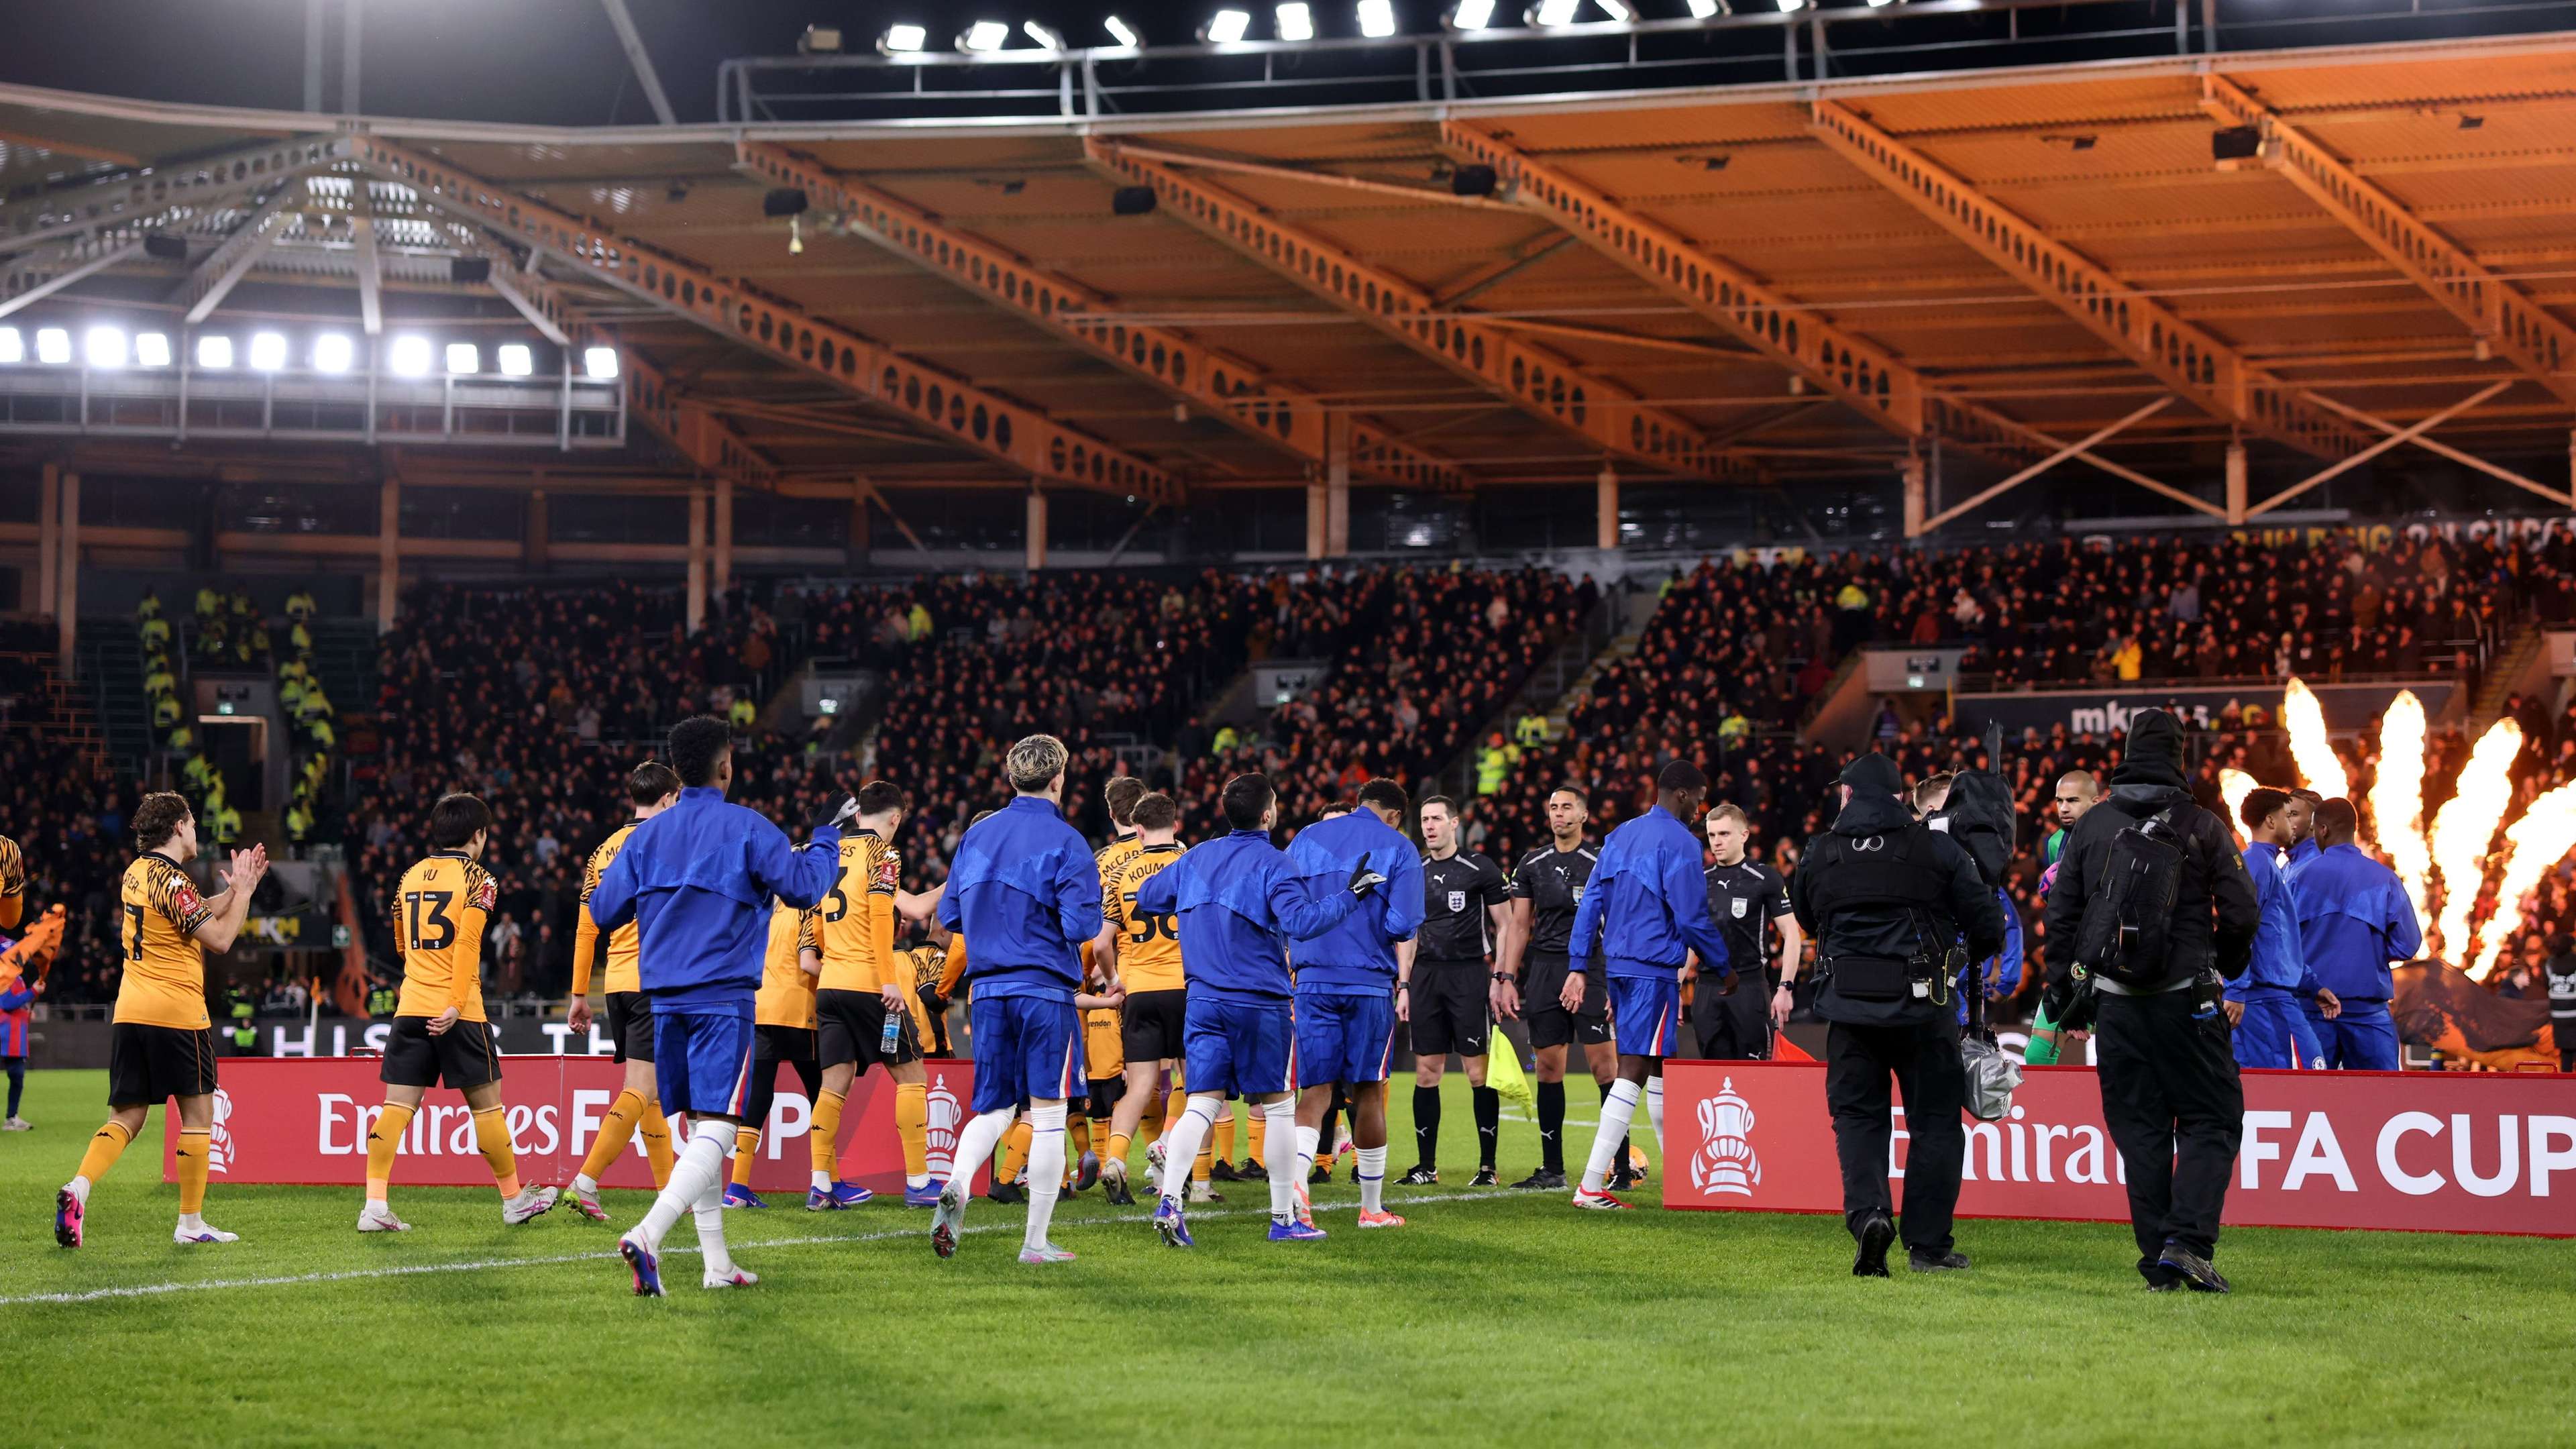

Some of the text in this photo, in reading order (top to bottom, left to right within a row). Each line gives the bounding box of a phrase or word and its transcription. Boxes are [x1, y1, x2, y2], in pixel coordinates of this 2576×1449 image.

[423, 869, 438, 881] YU
[1128, 863, 1165, 883] KOUM
[405, 891, 455, 950] 13
[1088, 1019, 1112, 1027] rendon
[2239, 1110, 2359, 1192] FA
[2375, 1111, 2576, 1197] CUP
